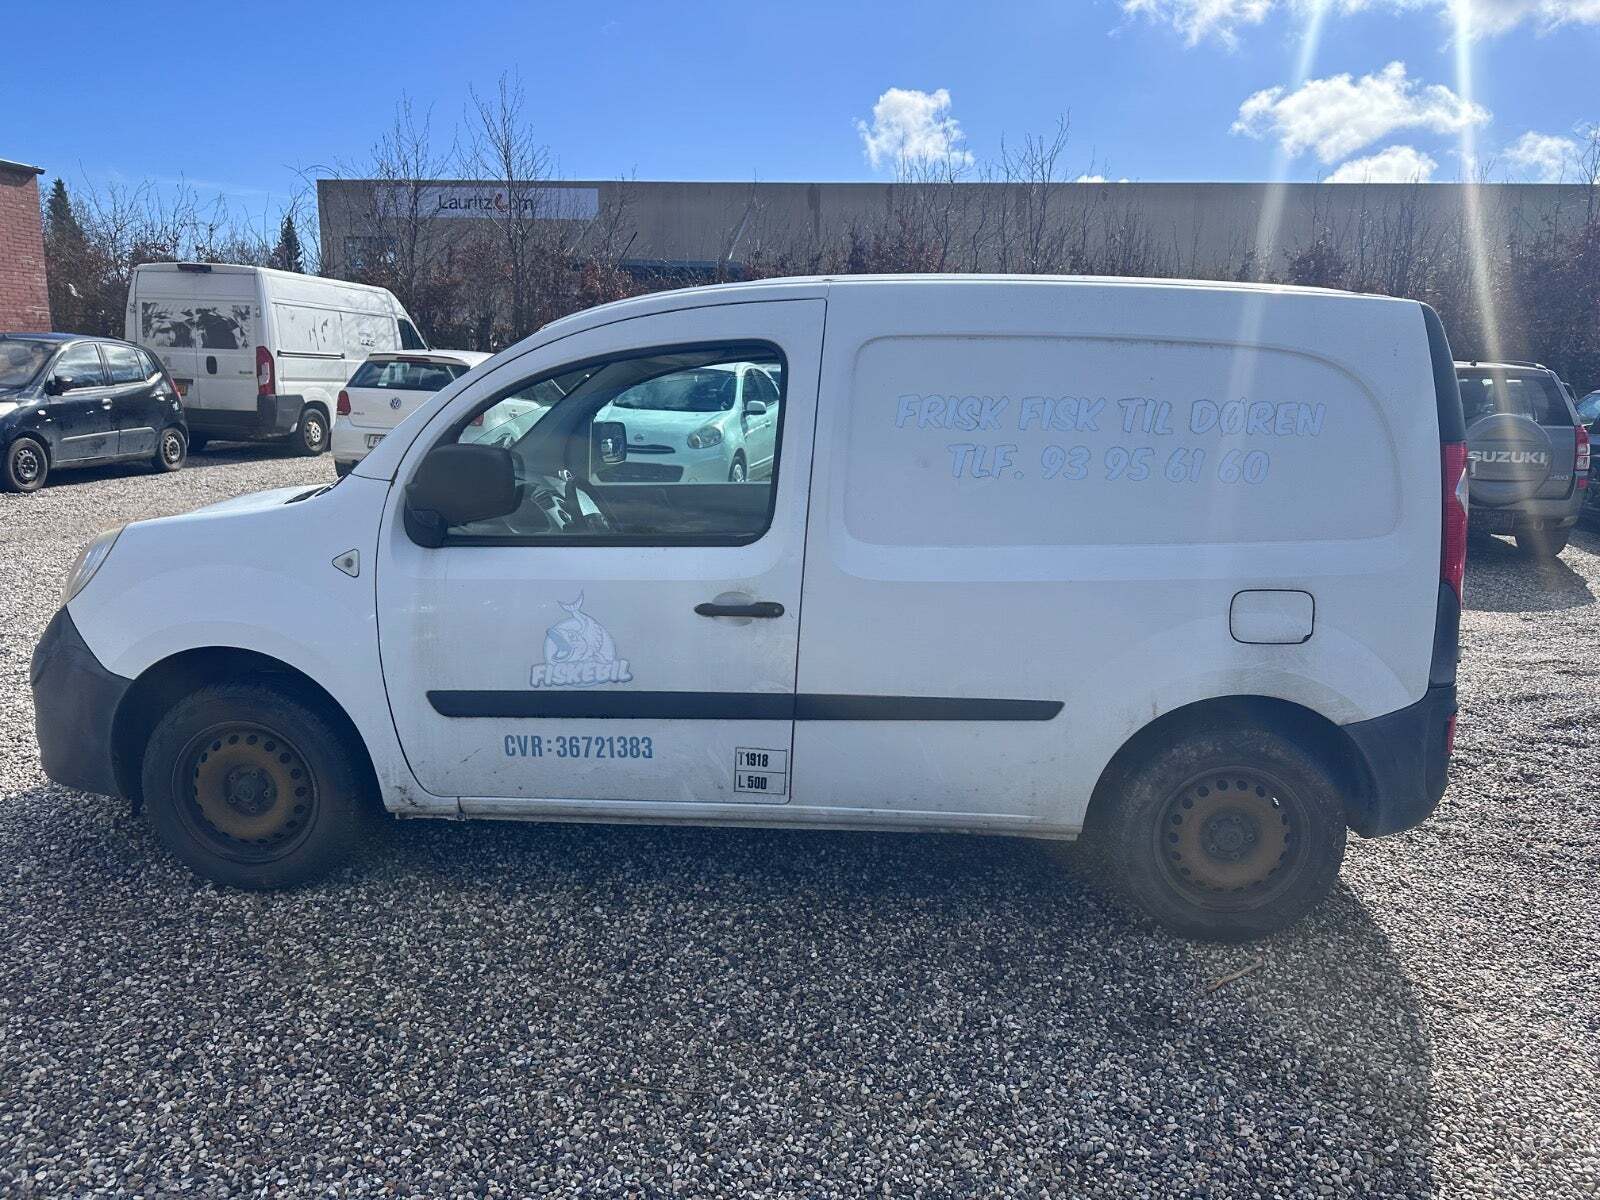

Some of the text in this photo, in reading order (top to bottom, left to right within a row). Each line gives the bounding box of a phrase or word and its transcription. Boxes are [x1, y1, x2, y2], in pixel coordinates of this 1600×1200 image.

[895, 394, 1327, 436] FRISK FISK TIL DØREN
[947, 443, 1270, 485] TLF. 93 95 61 60
[1467, 451, 1546, 465] SUZUKI
[530, 659, 633, 688] FISKEBIL
[738, 774, 768, 790] L 500
